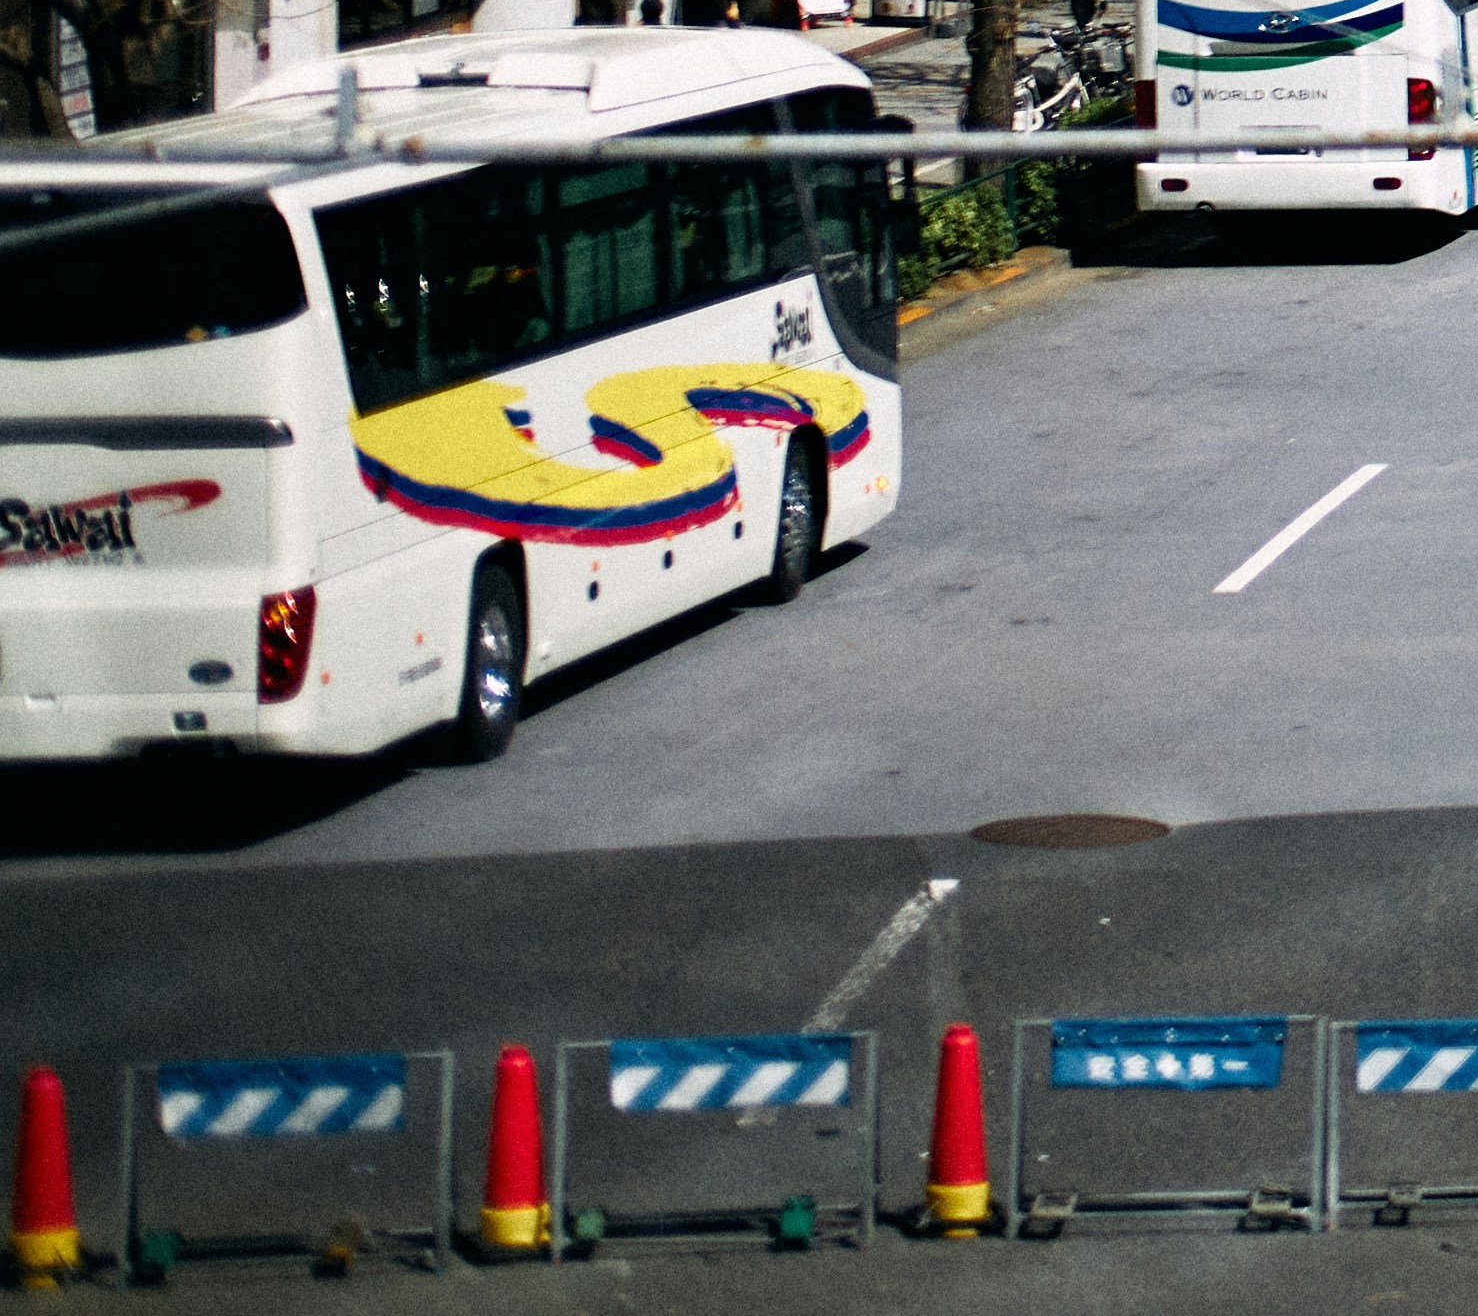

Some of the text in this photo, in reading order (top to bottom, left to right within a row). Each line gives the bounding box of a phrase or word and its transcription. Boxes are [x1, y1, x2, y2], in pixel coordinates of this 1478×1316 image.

[1203, 87, 1328, 101] WORLD CABIN
[0, 490, 136, 553] Sawai
